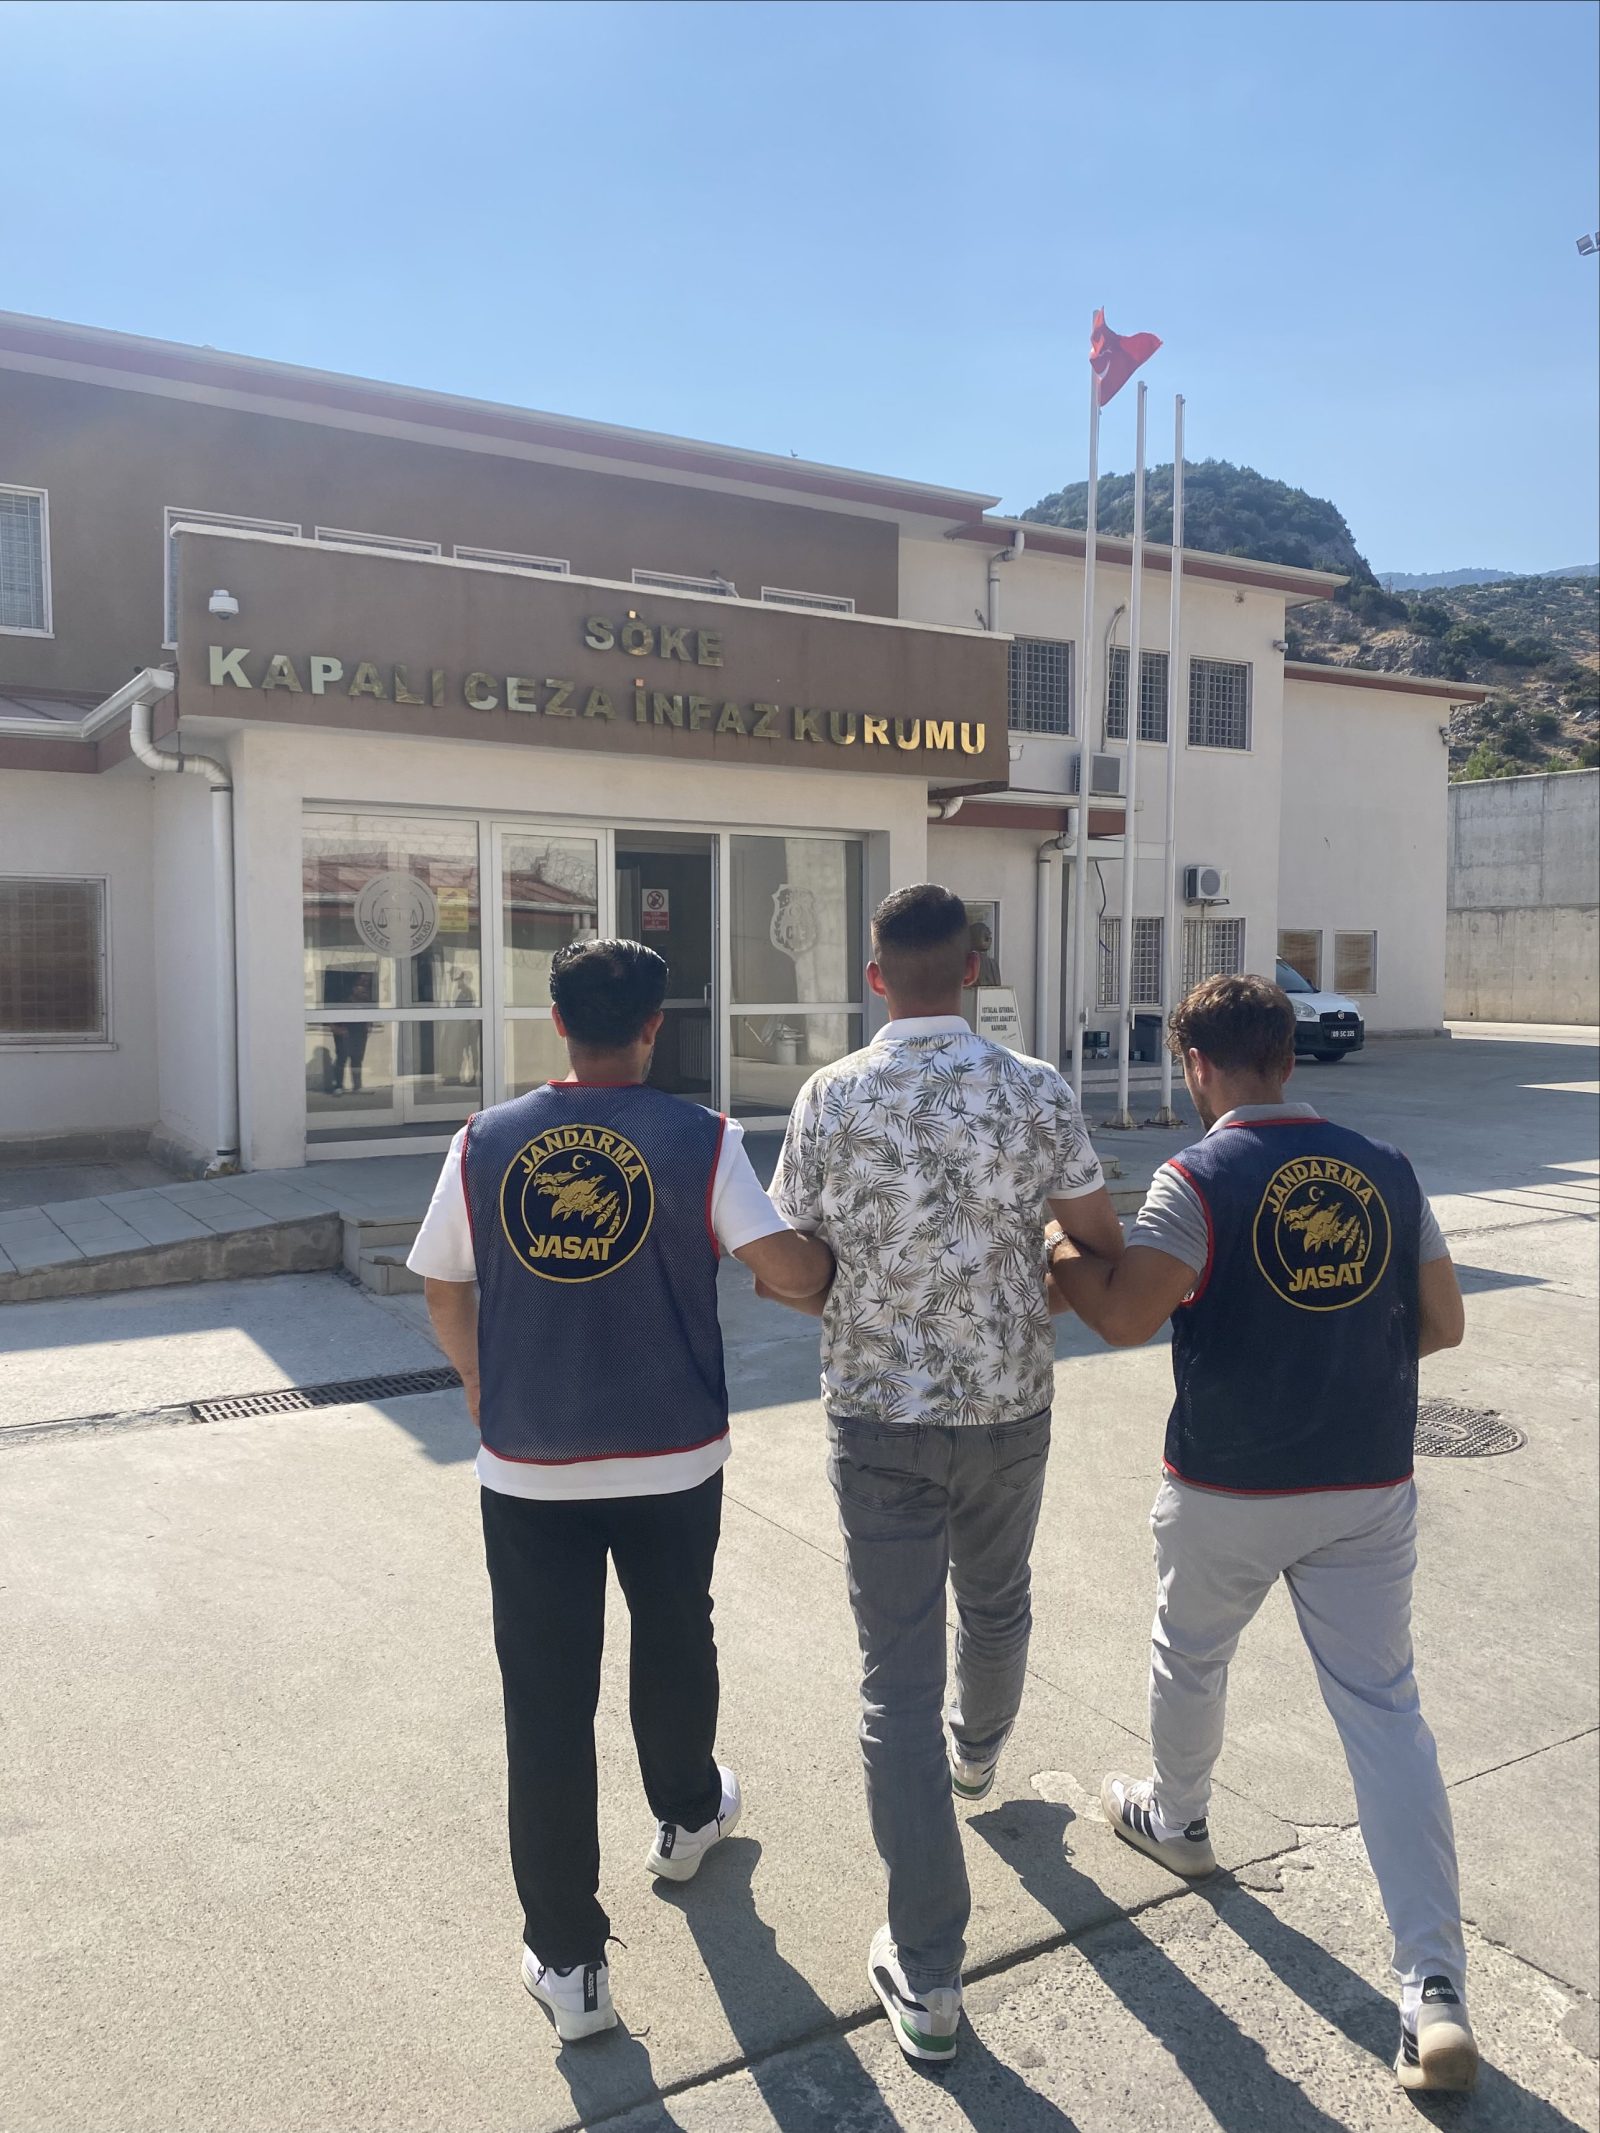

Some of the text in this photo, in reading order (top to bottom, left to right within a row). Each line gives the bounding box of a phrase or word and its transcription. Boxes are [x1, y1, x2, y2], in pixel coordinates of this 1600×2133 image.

[585, 610, 723, 667] SÖKE
[209, 645, 986, 755] KAPALI CEZA İNFAZ KURUMU
[519, 1129, 643, 1183] JANDARMA
[1266, 1160, 1374, 1214] JANDARMA
[529, 1234, 615, 1261] JASAT
[1288, 1261, 1366, 1292] JASAT
